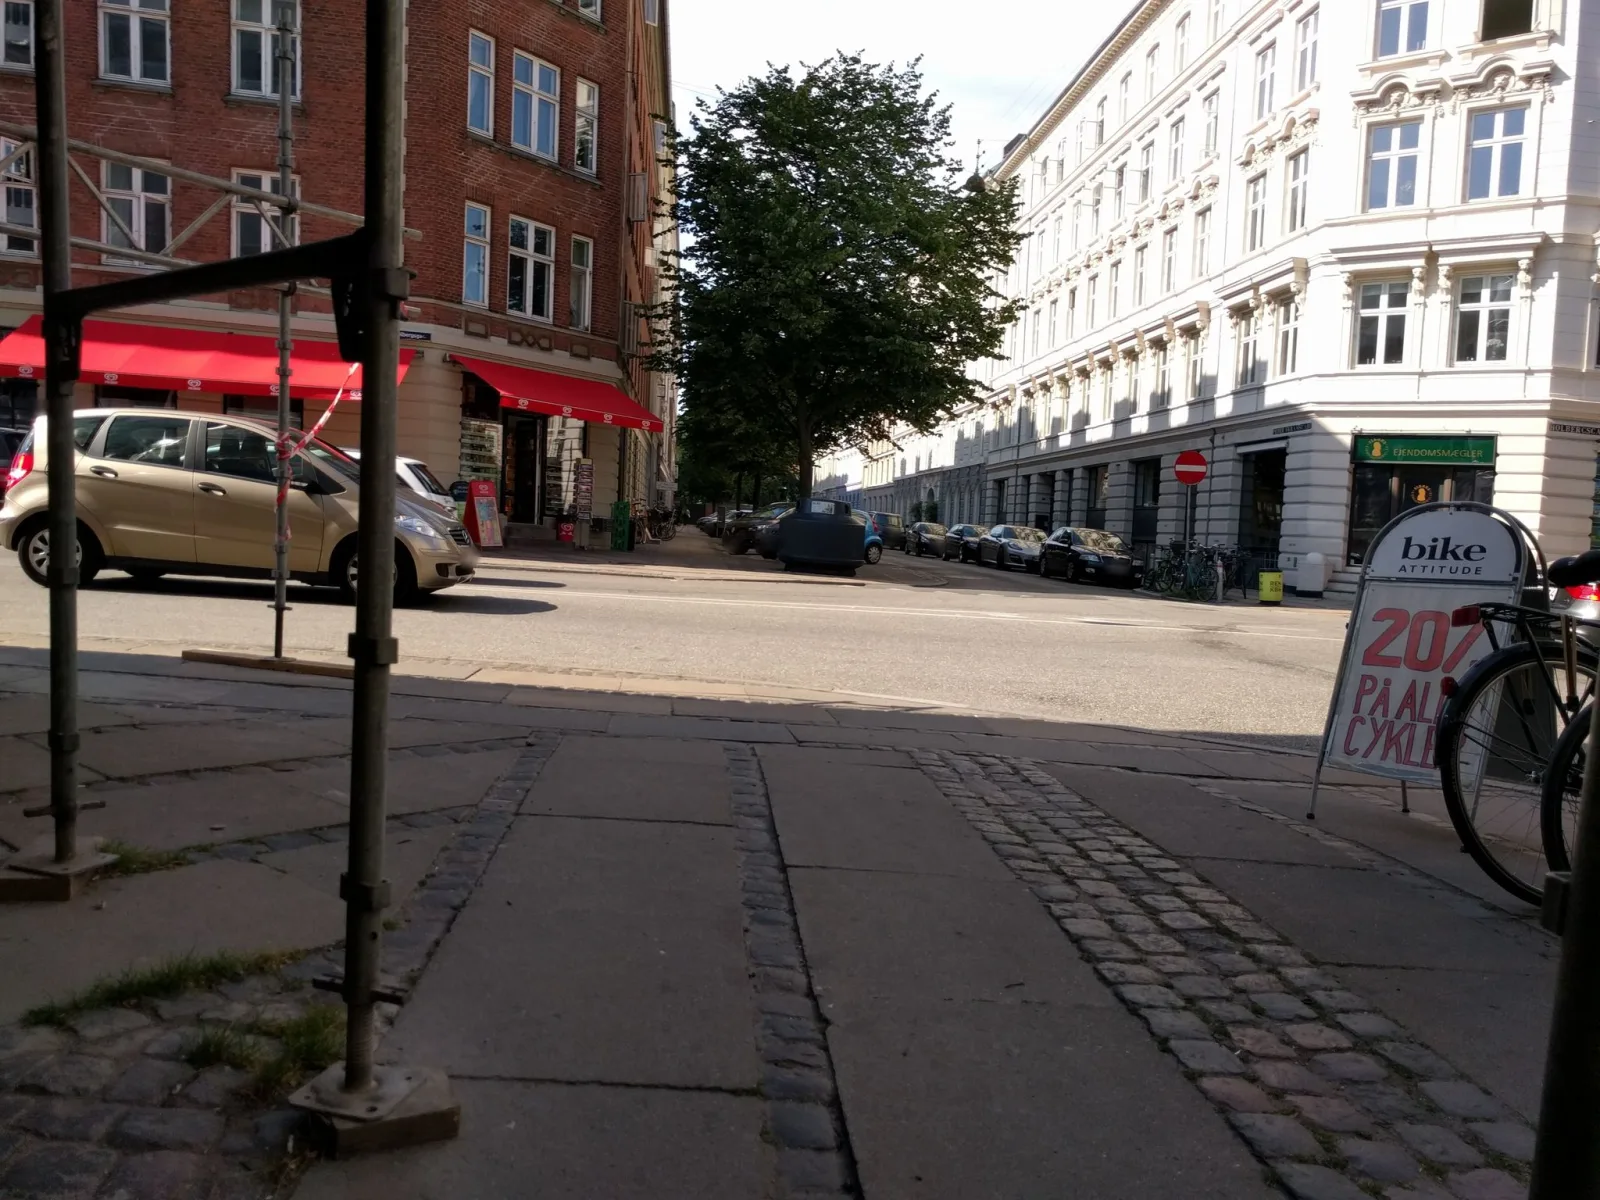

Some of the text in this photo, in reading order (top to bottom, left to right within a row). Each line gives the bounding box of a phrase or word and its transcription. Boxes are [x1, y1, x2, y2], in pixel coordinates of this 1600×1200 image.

[1393, 448, 1483, 458] EJENDOMSMÆGLER
[1401, 536, 1487, 562] bike
[1398, 564, 1482, 576] ATTITUDE
[1352, 674, 1391, 719] PÅ
[1343, 715, 1448, 770] CYKLE
